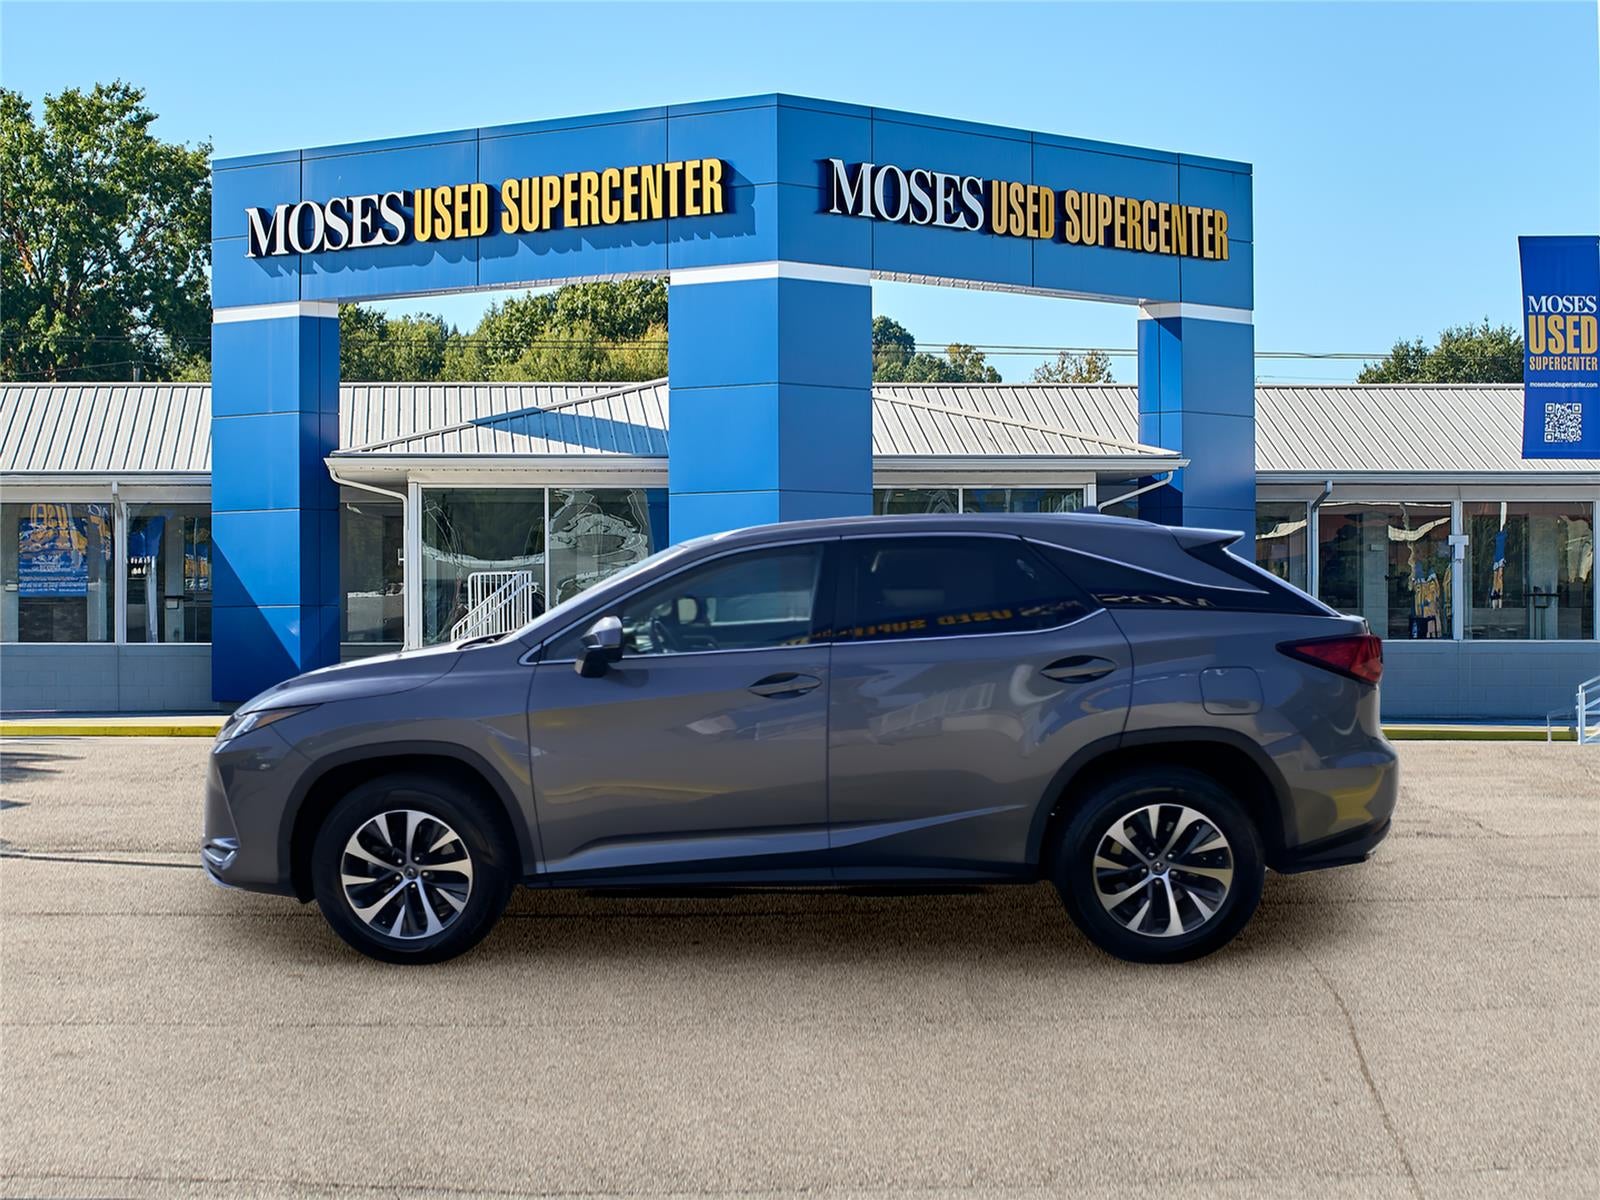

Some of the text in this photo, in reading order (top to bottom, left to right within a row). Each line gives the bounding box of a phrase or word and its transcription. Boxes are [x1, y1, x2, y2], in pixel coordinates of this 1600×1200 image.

[245, 158, 724, 257] MOSES USED SUPERCENTER
[828, 158, 1229, 260] MOSES USED SUPERCENTER
[1528, 295, 1597, 313] MOSES
[1528, 315, 1598, 354] USED
[1529, 356, 1598, 371] SUPERCENTER
